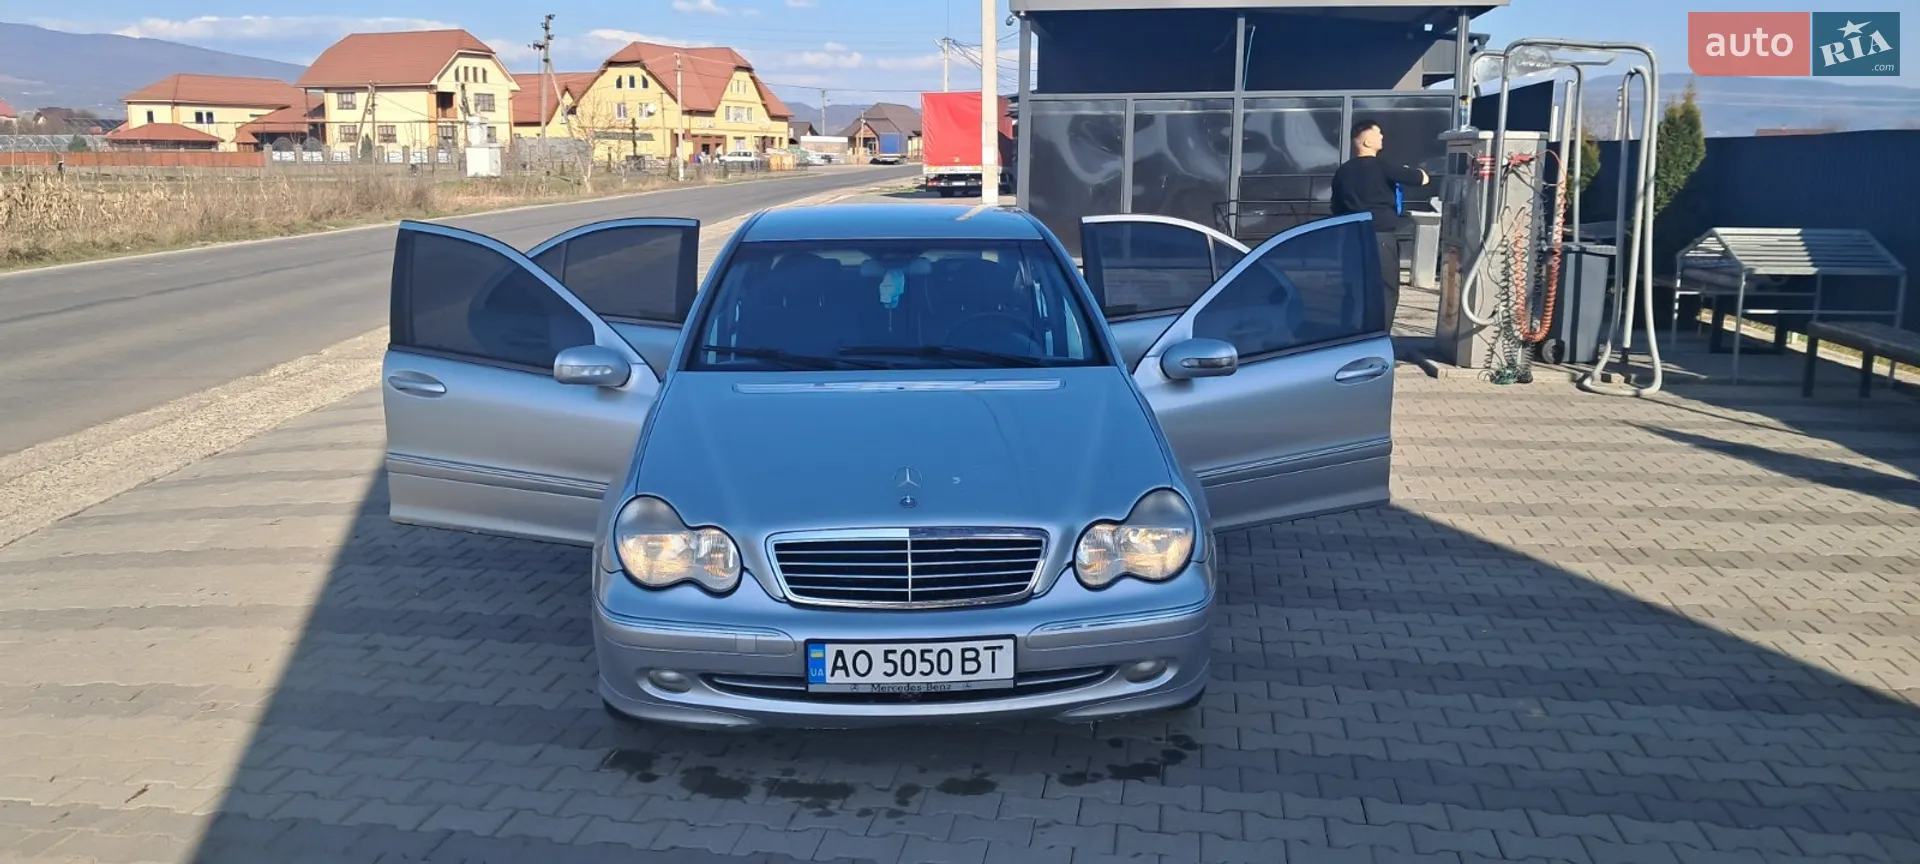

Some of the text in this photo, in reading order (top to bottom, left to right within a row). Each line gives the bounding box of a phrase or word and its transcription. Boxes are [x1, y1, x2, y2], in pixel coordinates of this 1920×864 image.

[830, 645, 1004, 678] AO 5050 BT
[810, 668, 825, 677] UA
